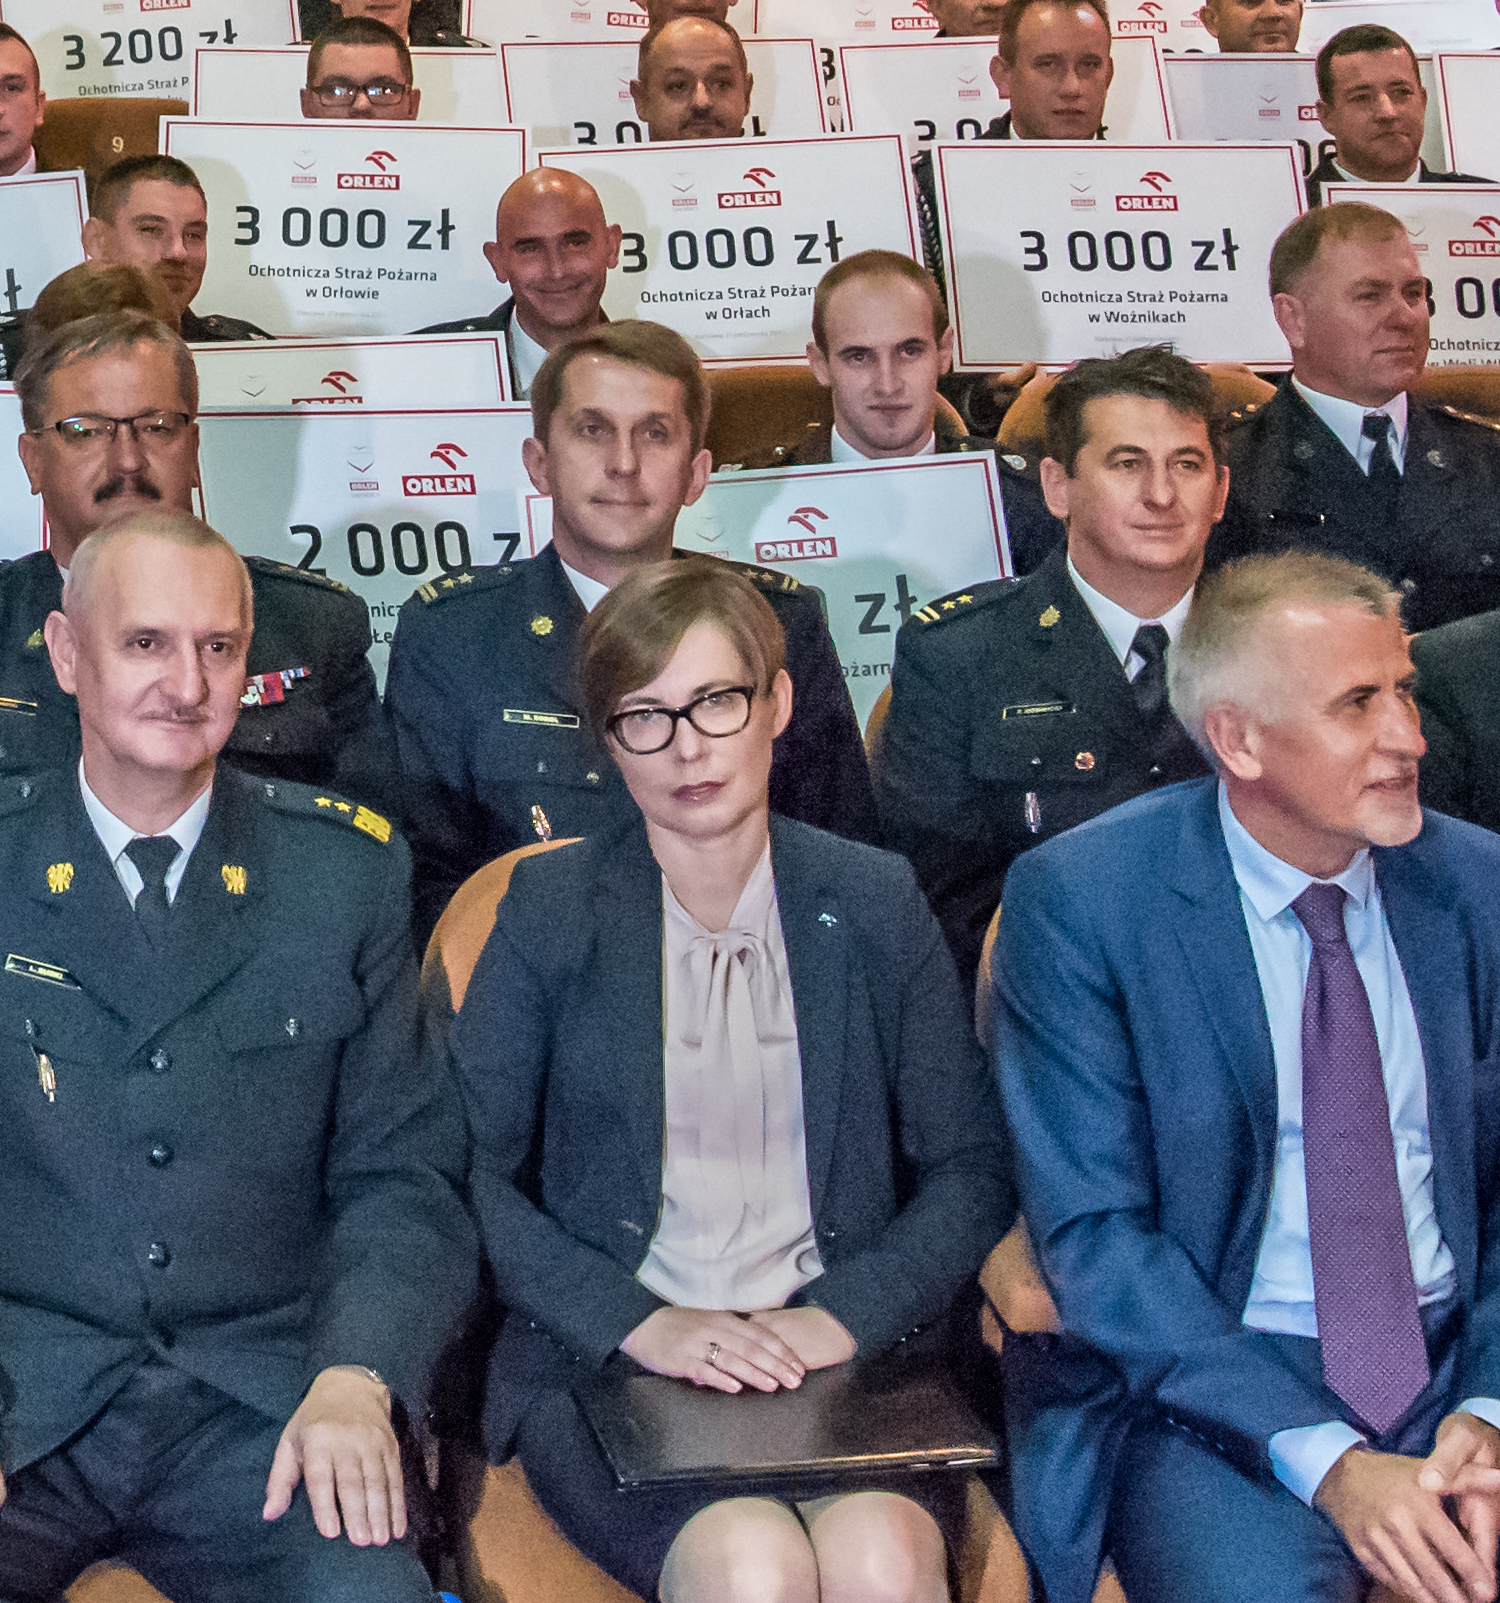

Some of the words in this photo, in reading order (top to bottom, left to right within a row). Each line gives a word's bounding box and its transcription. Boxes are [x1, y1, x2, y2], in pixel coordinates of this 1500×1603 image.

[339, 175, 398, 188] ORLEN
[719, 193, 779, 206] ORLEN
[1117, 197, 1176, 210] ORLEN
[235, 206, 259, 245] 3
[282, 207, 385, 248] 000
[408, 208, 455, 250] zł
[623, 233, 647, 273] 3
[668, 227, 774, 270] 000
[794, 219, 843, 265] zł
[1020, 231, 1048, 271] 3
[1068, 231, 1172, 271] 000
[1192, 228, 1239, 270] zł
[249, 265, 329, 278] Ochotnicza
[335, 267, 372, 279] Straż
[378, 268, 436, 281] Pożarna
[306, 289, 317, 297] w
[323, 286, 379, 299] Orłowie
[1042, 290, 1122, 303] Ochotnicza
[1127, 291, 1164, 303] Straż
[1169, 290, 1228, 302] Pożarna
[705, 311, 717, 320] w
[722, 306, 770, 319] Orłach
[1088, 314, 1100, 323] w
[1104, 311, 1186, 323] Woźnikach
[405, 476, 474, 493] ORLEN
[290, 525, 327, 575] 2
[347, 521, 473, 577] 000
